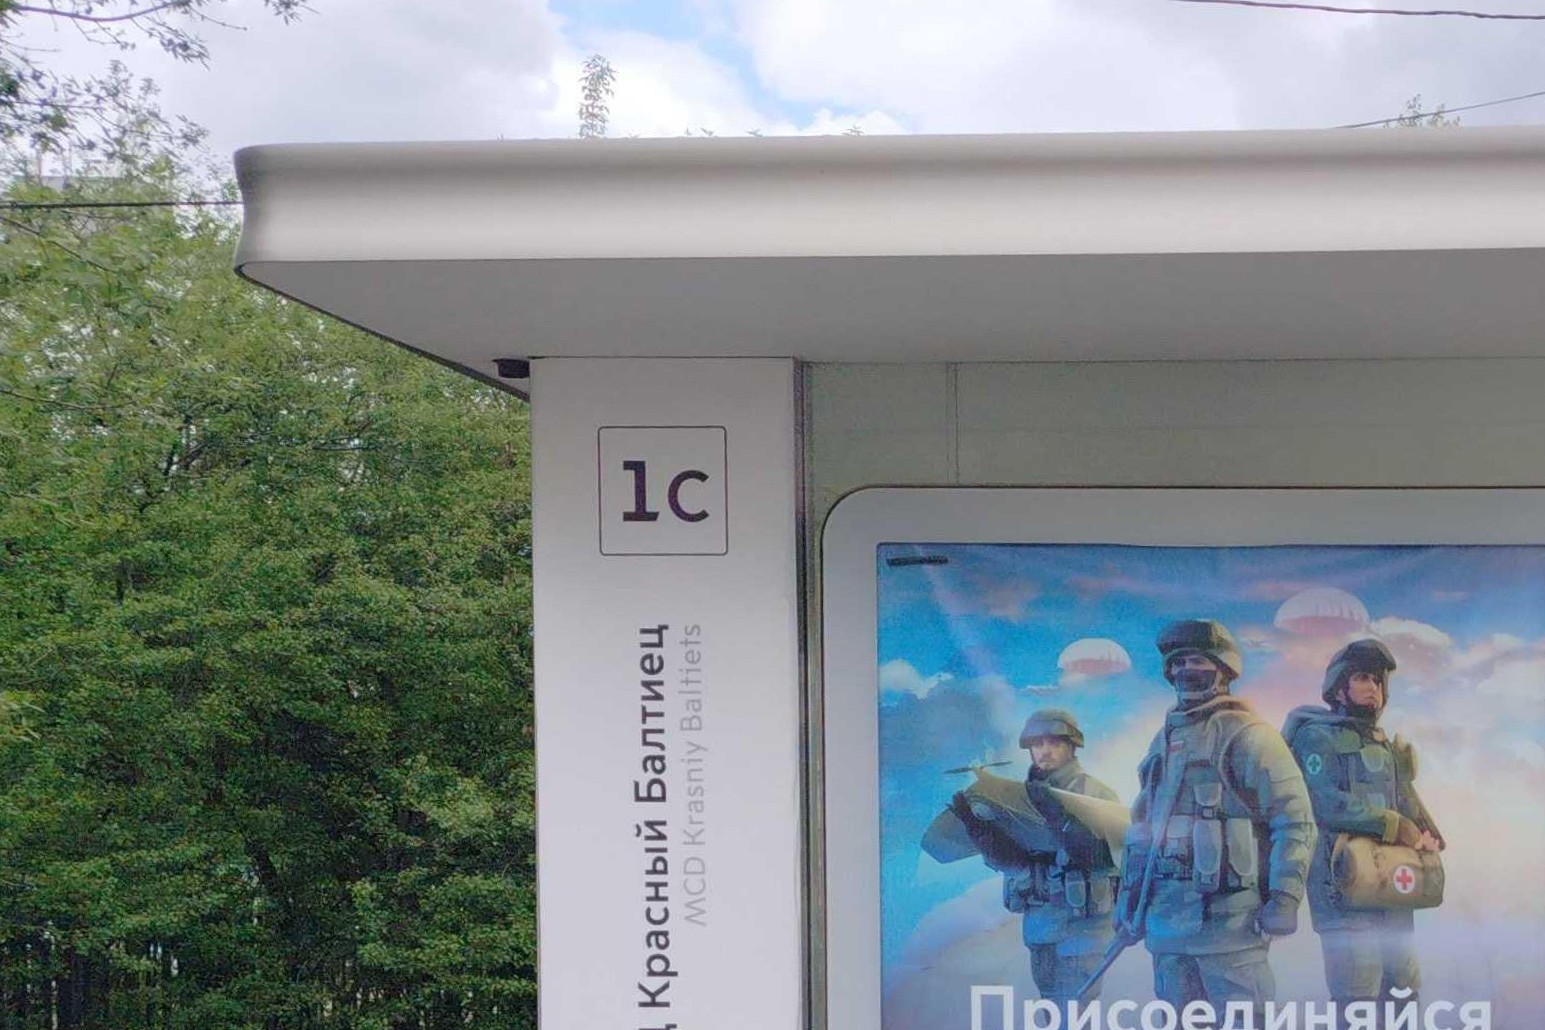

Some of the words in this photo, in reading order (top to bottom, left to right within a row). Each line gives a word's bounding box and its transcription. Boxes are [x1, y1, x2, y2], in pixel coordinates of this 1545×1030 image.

[633, 623, 670, 803] Балтиец
[678, 623, 703, 732] Baltiets
[681, 741, 709, 846] Krasniy
[636, 820, 679, 1008] Красный
[682, 856, 707, 927] MCD
